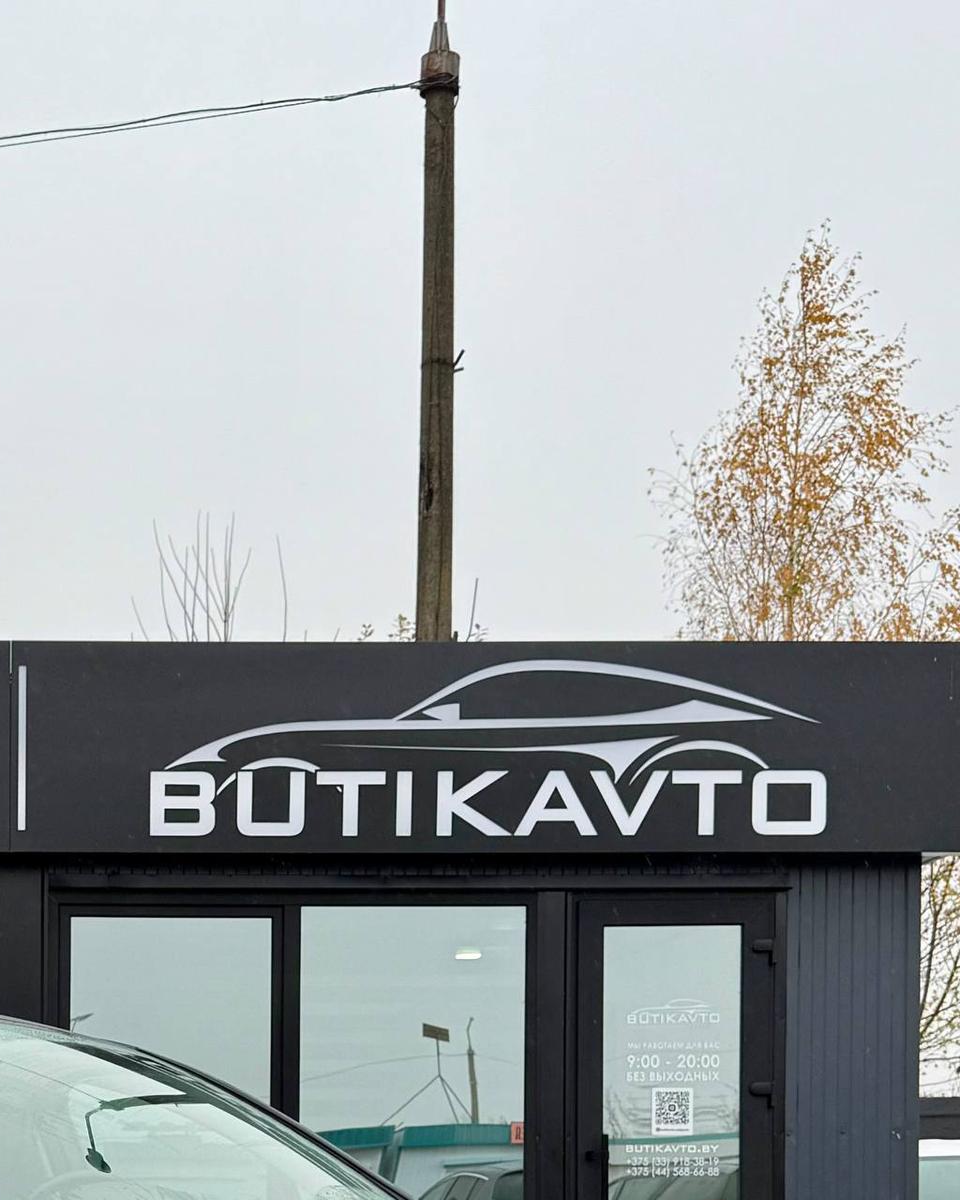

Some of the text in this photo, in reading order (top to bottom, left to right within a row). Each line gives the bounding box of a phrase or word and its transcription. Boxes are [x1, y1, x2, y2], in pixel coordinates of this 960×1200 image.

[149, 769, 828, 838] BUTIKAVTO
[626, 1012, 721, 1025] BUTIKAVTO
[627, 1054, 660, 1068] 9:00
[677, 1054, 721, 1068] 20:00
[626, 1071, 720, 1082] БЕЗ ВЫХОДНЫХ
[625, 1144, 720, 1154] BUTIKAVTO.BY
[626, 1156, 649, 1167] +375
[626, 1167, 649, 1177] +375
[652, 1166, 670, 1178] (44)
